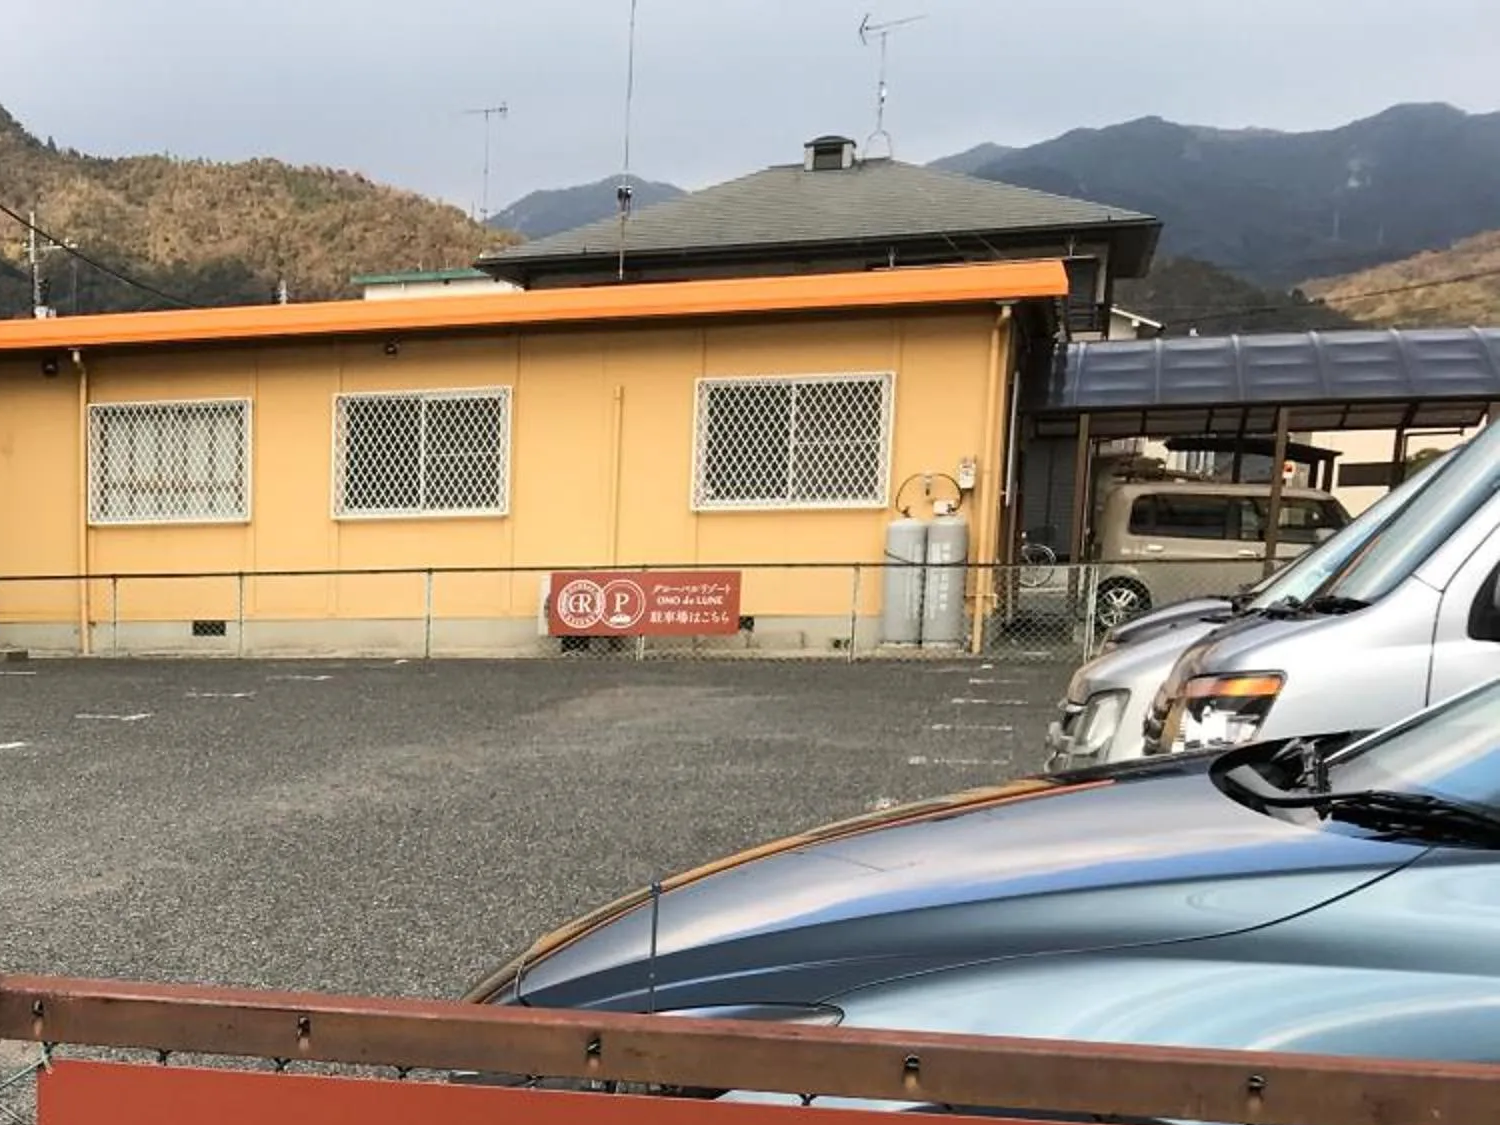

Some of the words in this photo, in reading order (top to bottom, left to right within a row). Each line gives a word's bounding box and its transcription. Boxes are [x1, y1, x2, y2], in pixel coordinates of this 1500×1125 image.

[614, 593, 629, 613] P
[650, 610, 730, 624] 駐車場はこちら
